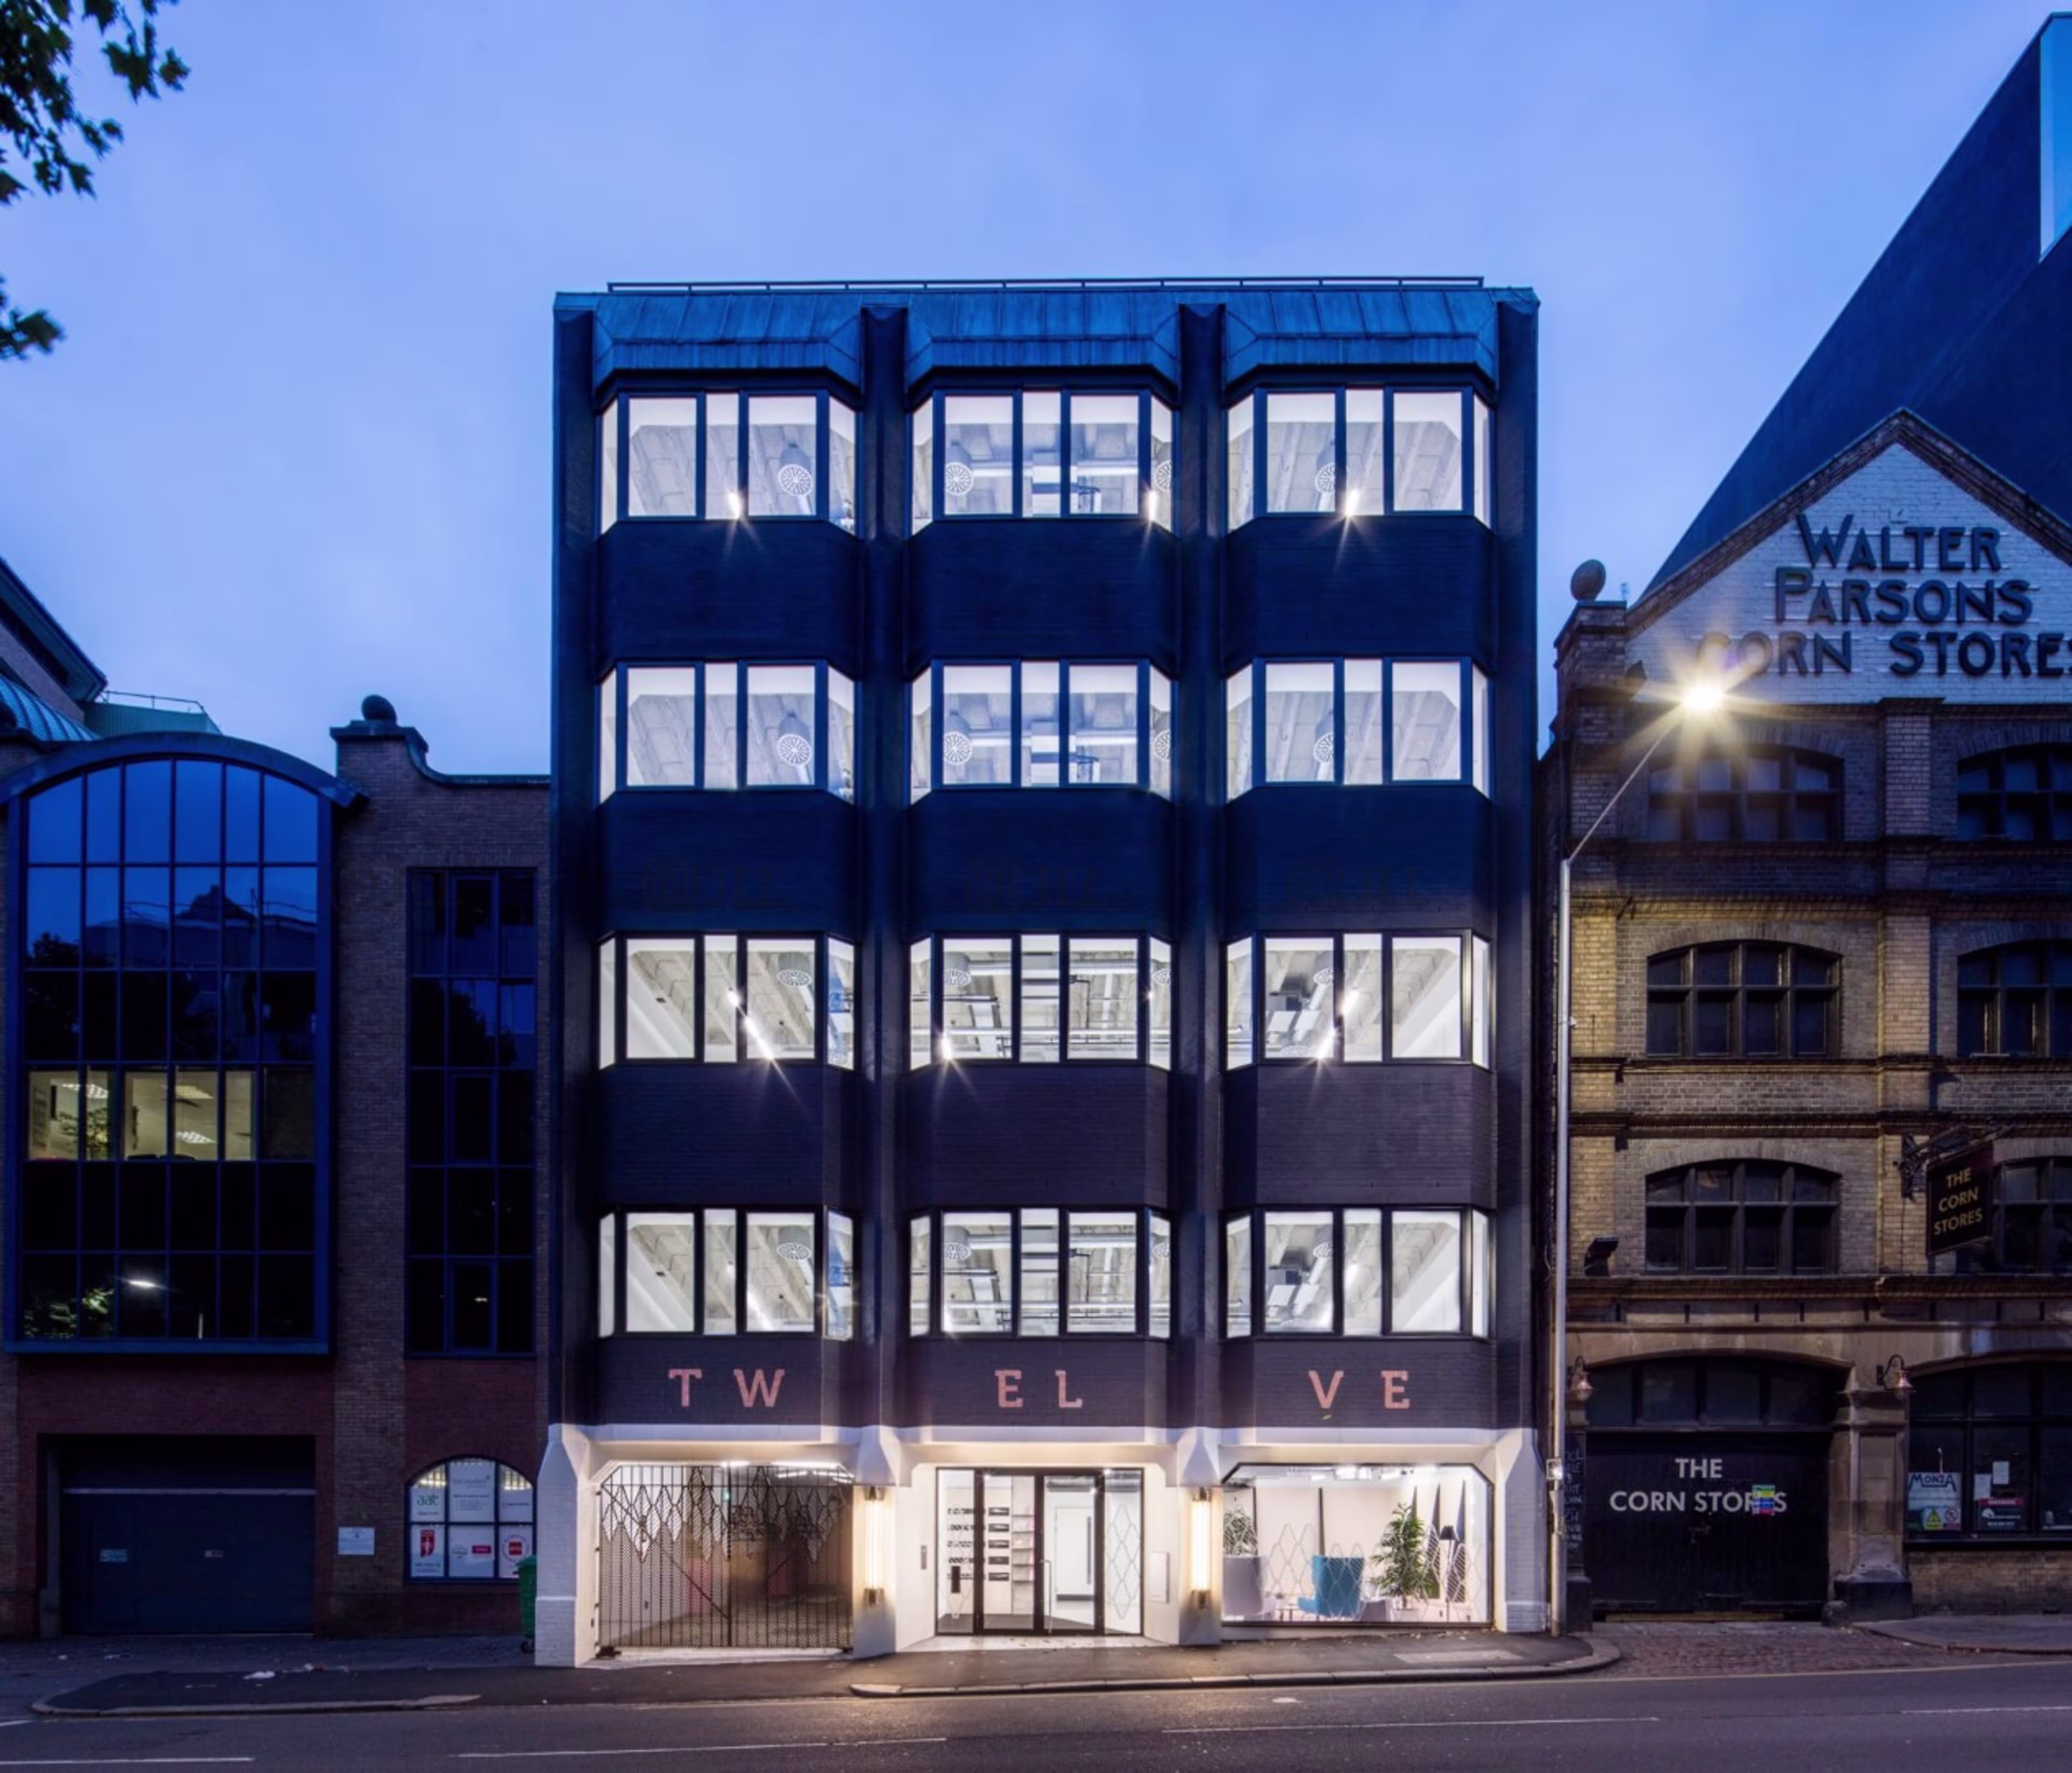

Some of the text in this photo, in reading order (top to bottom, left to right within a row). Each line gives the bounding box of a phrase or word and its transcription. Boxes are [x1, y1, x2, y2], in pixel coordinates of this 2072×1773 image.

[1797, 513, 2002, 572] WALTER
[1775, 567, 2033, 624] PARSONS
[1889, 630, 2072, 677] STORE
[1945, 1167, 1971, 1188] THE
[1938, 1188, 1979, 1212] CORN
[1933, 1208, 1983, 1236] STORES
[1675, 1458, 1722, 1478] THE
[1610, 1491, 1685, 1512] CORN
